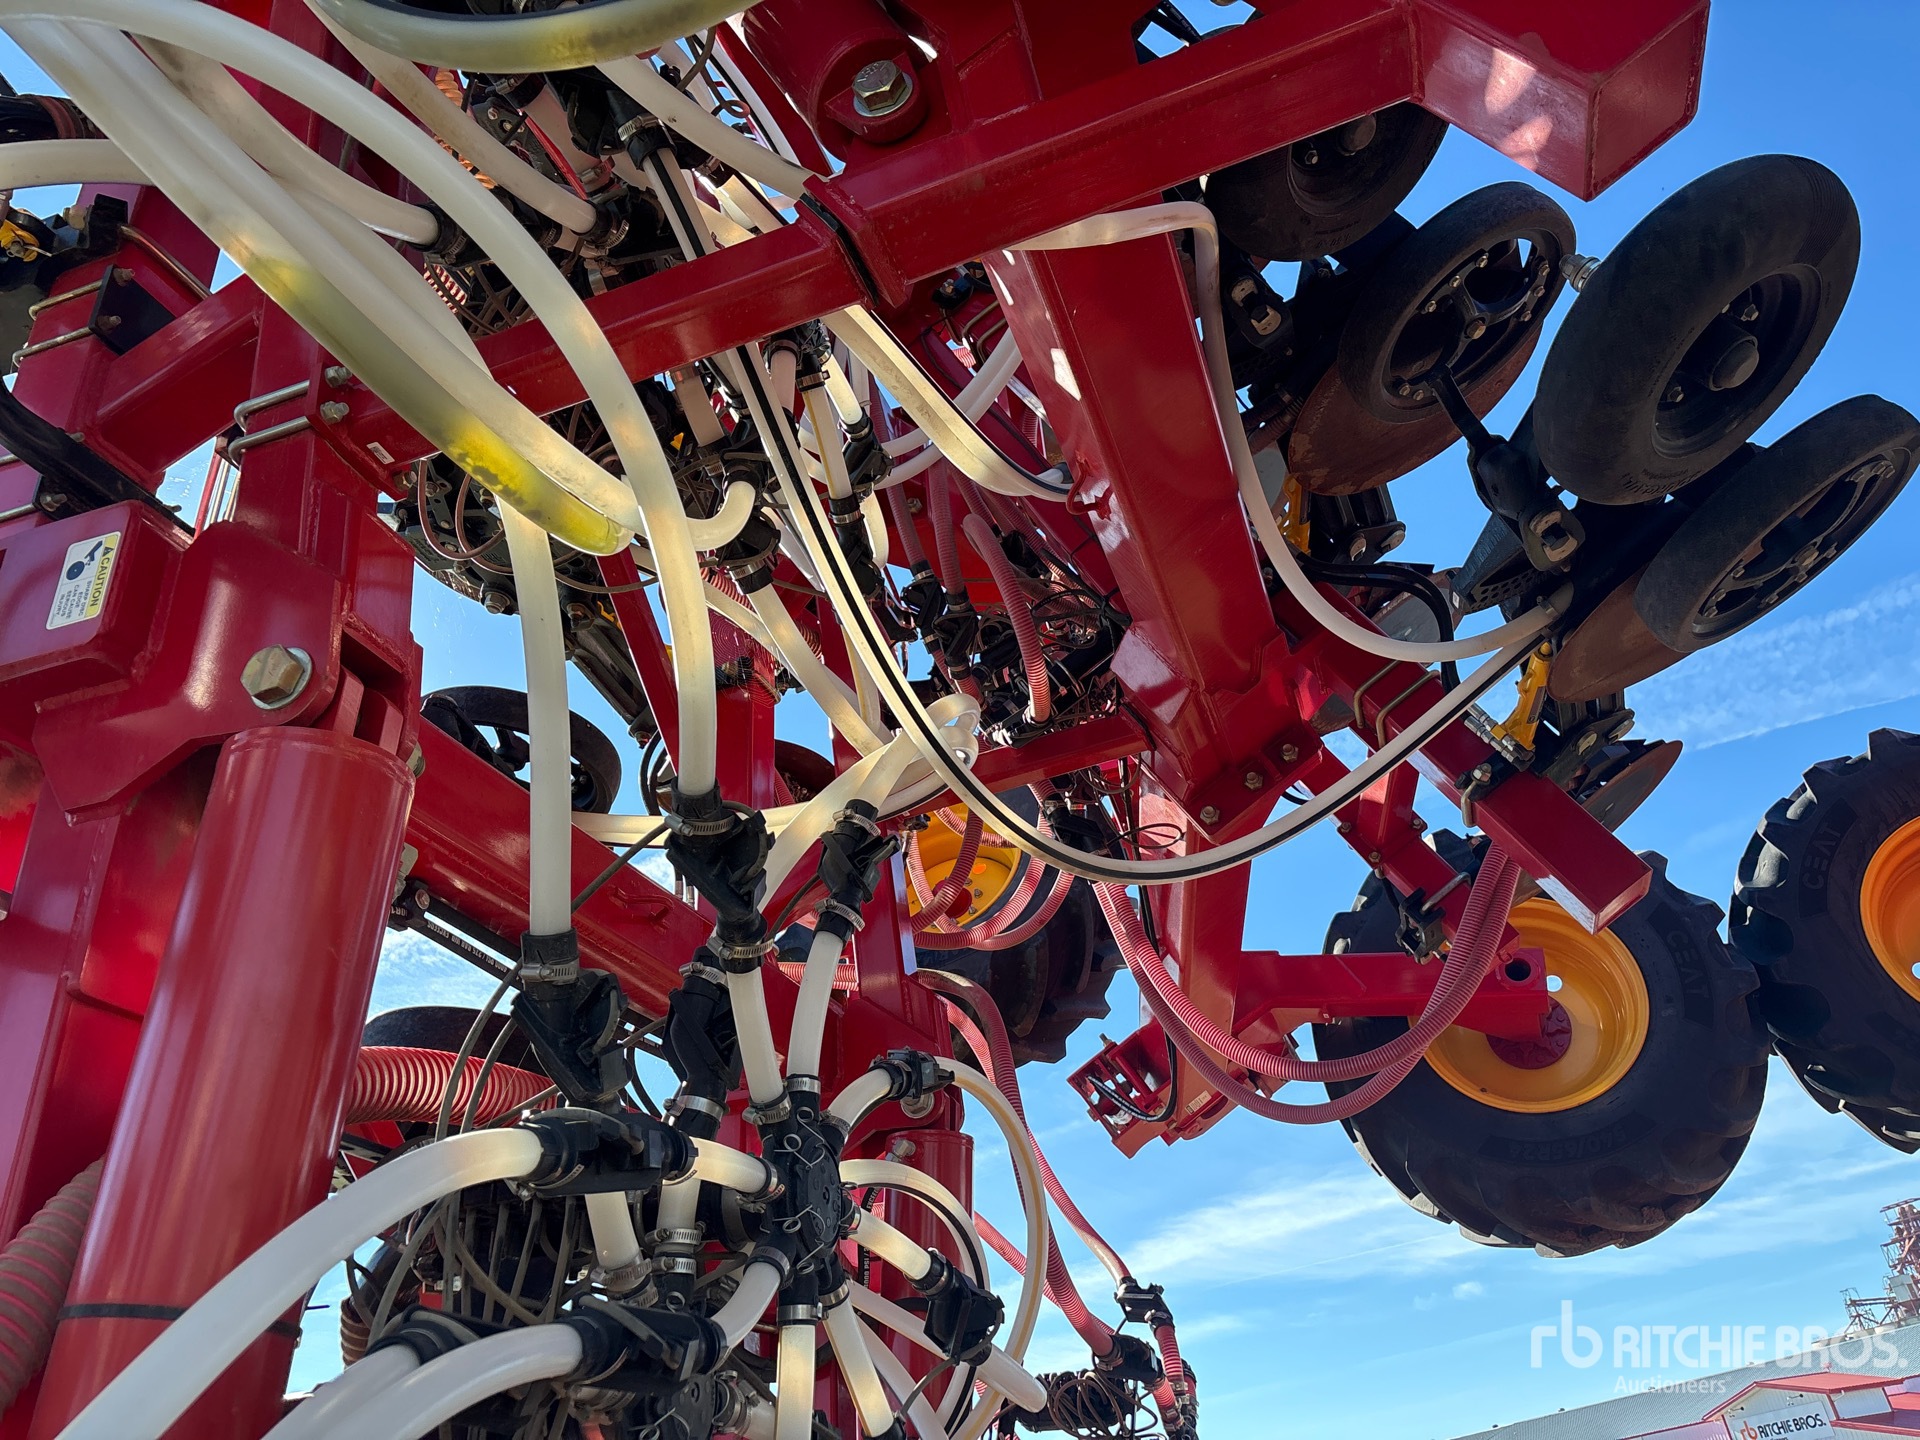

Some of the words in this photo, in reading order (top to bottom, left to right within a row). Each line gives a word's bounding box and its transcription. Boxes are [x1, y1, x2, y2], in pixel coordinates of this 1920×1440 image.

[83, 580, 92, 601] SHARP
[90, 557, 110, 607] CAUTION
[61, 590, 72, 617] SERIOUS
[66, 599, 76, 619] CAUSE
[75, 591, 83, 609] EDGE
[1757, 1419, 1794, 1439] RITCHIE
[1792, 1413, 1827, 1431] BROS.
